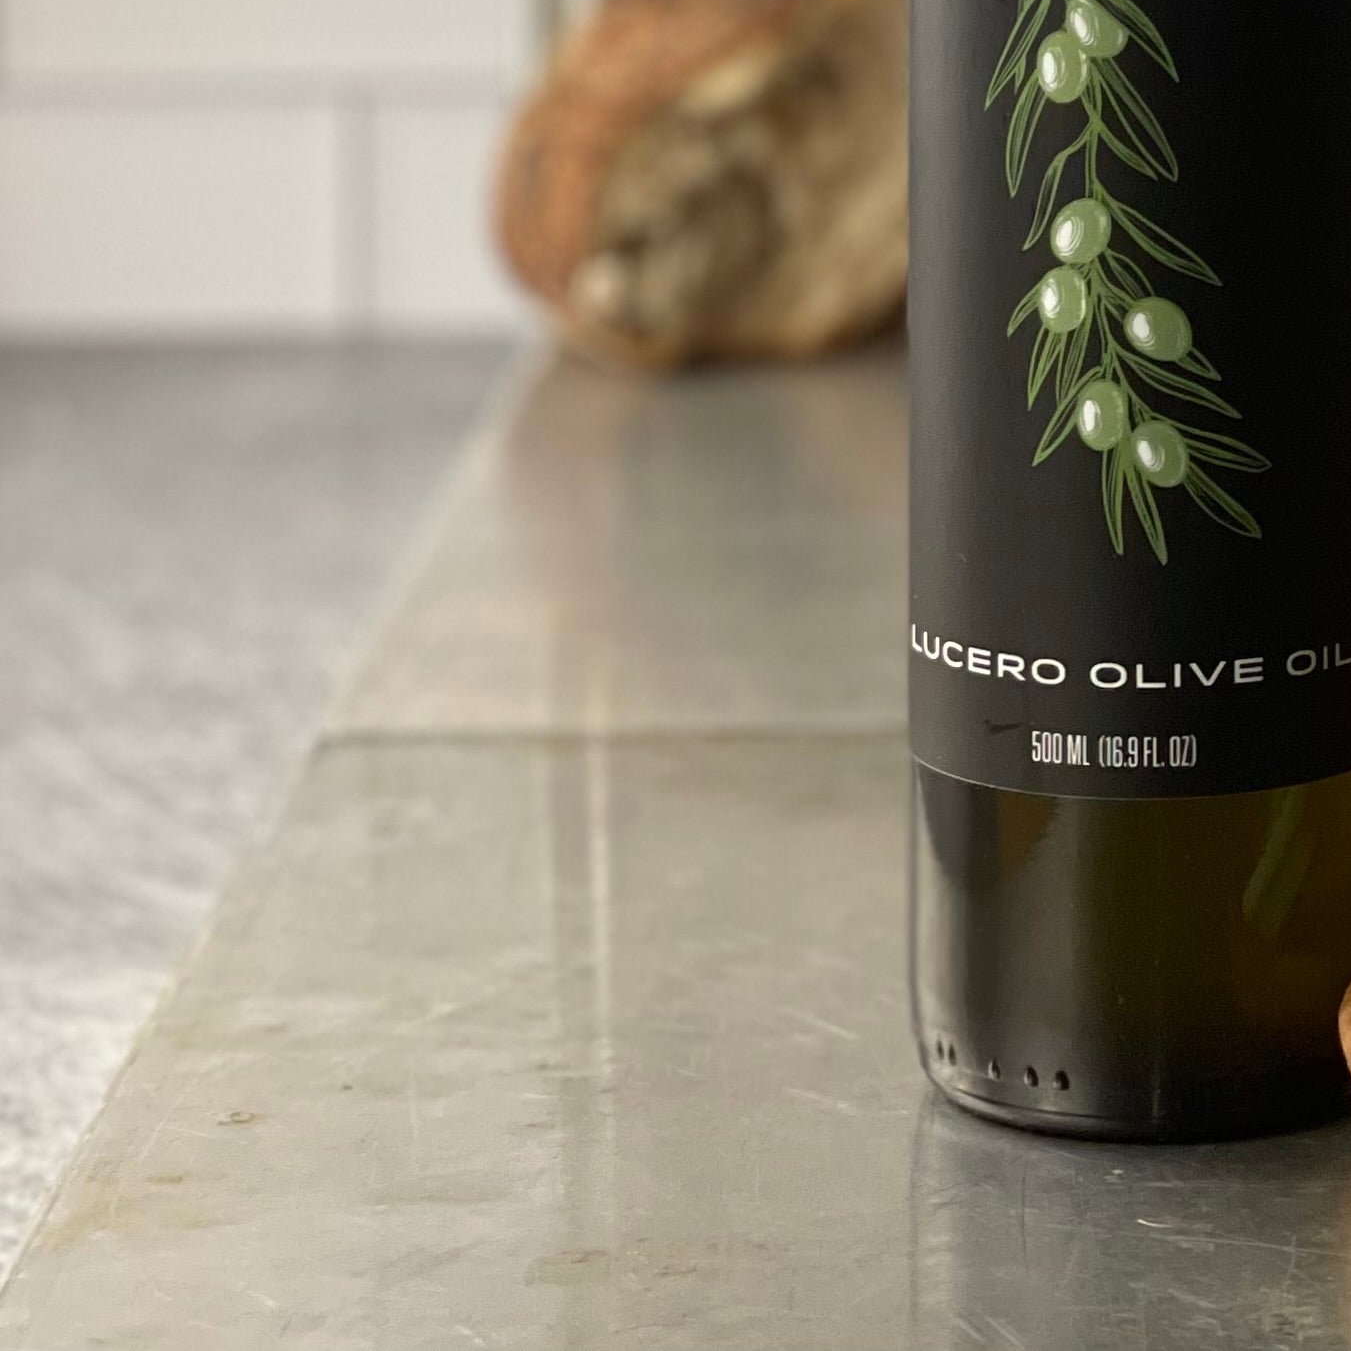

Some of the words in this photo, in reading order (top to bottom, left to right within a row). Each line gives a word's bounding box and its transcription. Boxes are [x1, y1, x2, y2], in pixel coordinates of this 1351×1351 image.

[911, 623, 1067, 685] LUCERO
[1090, 655, 1264, 689] OLIVE
[1031, 730, 1062, 764] 500
[1067, 734, 1090, 766] ML
[1098, 734, 1138, 768] (16.9
[1143, 736, 1165, 767] FL.
[1169, 734, 1197, 767] OZ)
